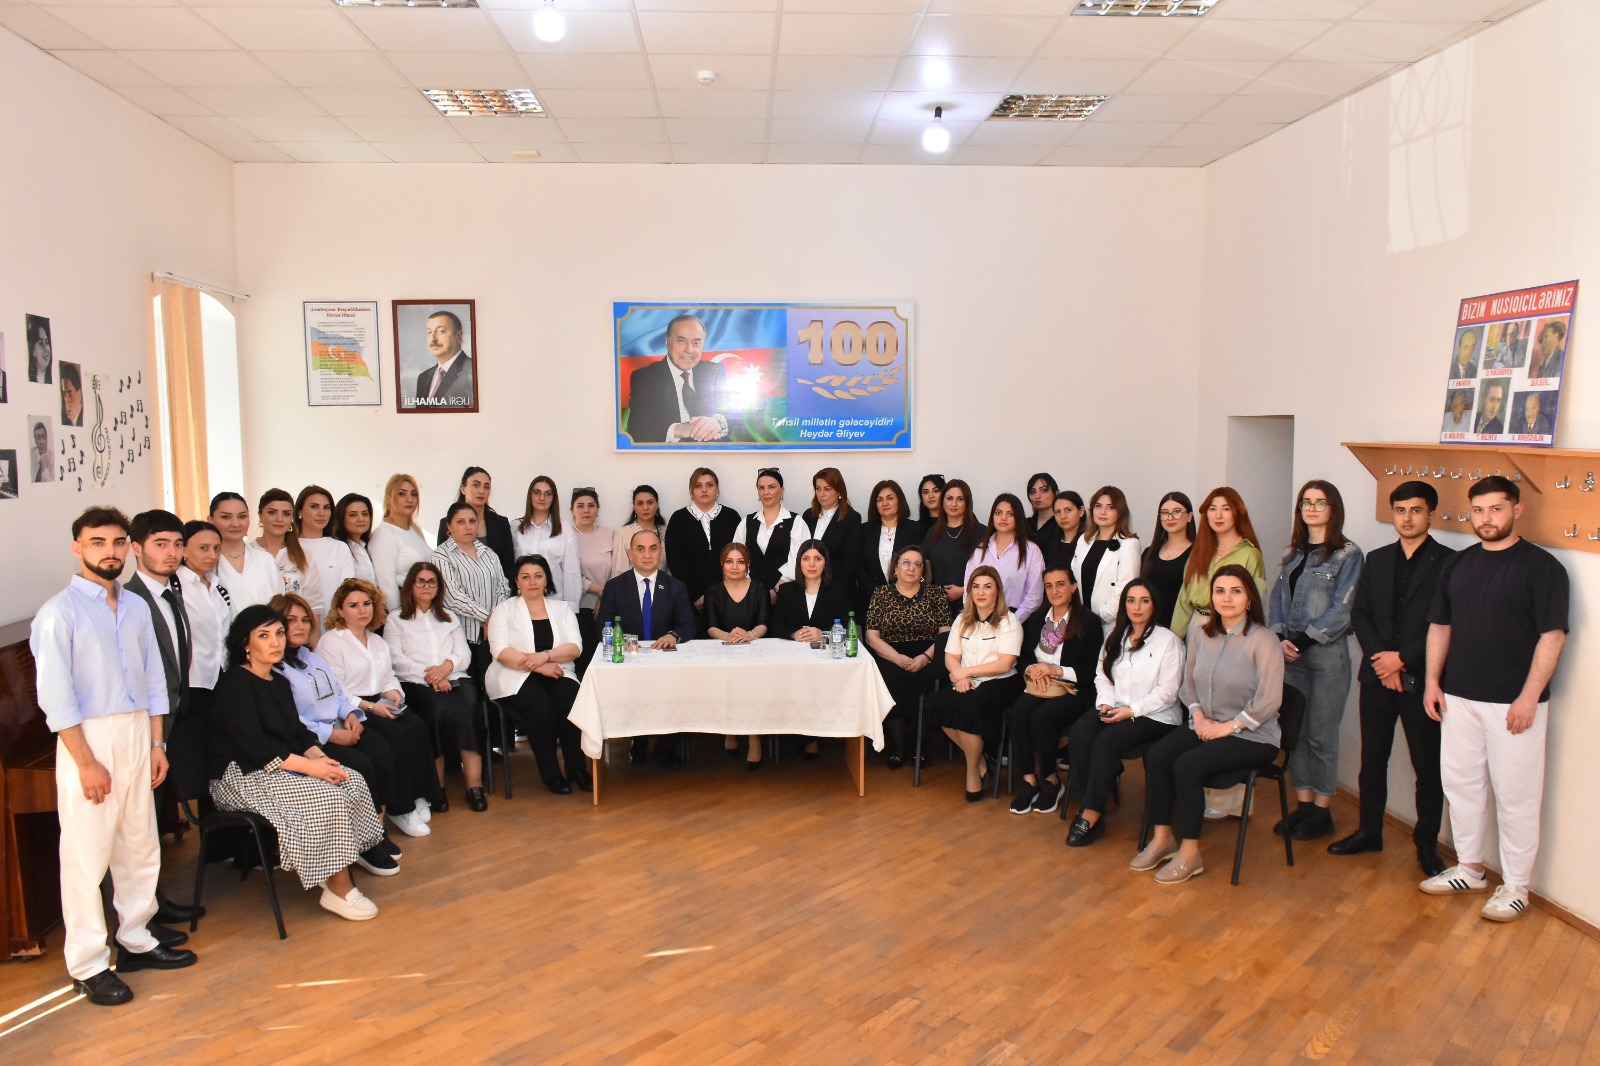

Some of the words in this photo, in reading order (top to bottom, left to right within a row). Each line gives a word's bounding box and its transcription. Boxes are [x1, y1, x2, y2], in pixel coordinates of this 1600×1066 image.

[798, 320, 898, 366] 100
[404, 395, 447, 406] İLHAMLA
[801, 417, 837, 427] millətin
[838, 417, 894, 429] gələcəyidir!
[799, 429, 834, 439] Heydər
[835, 429, 866, 440] Əliyev
